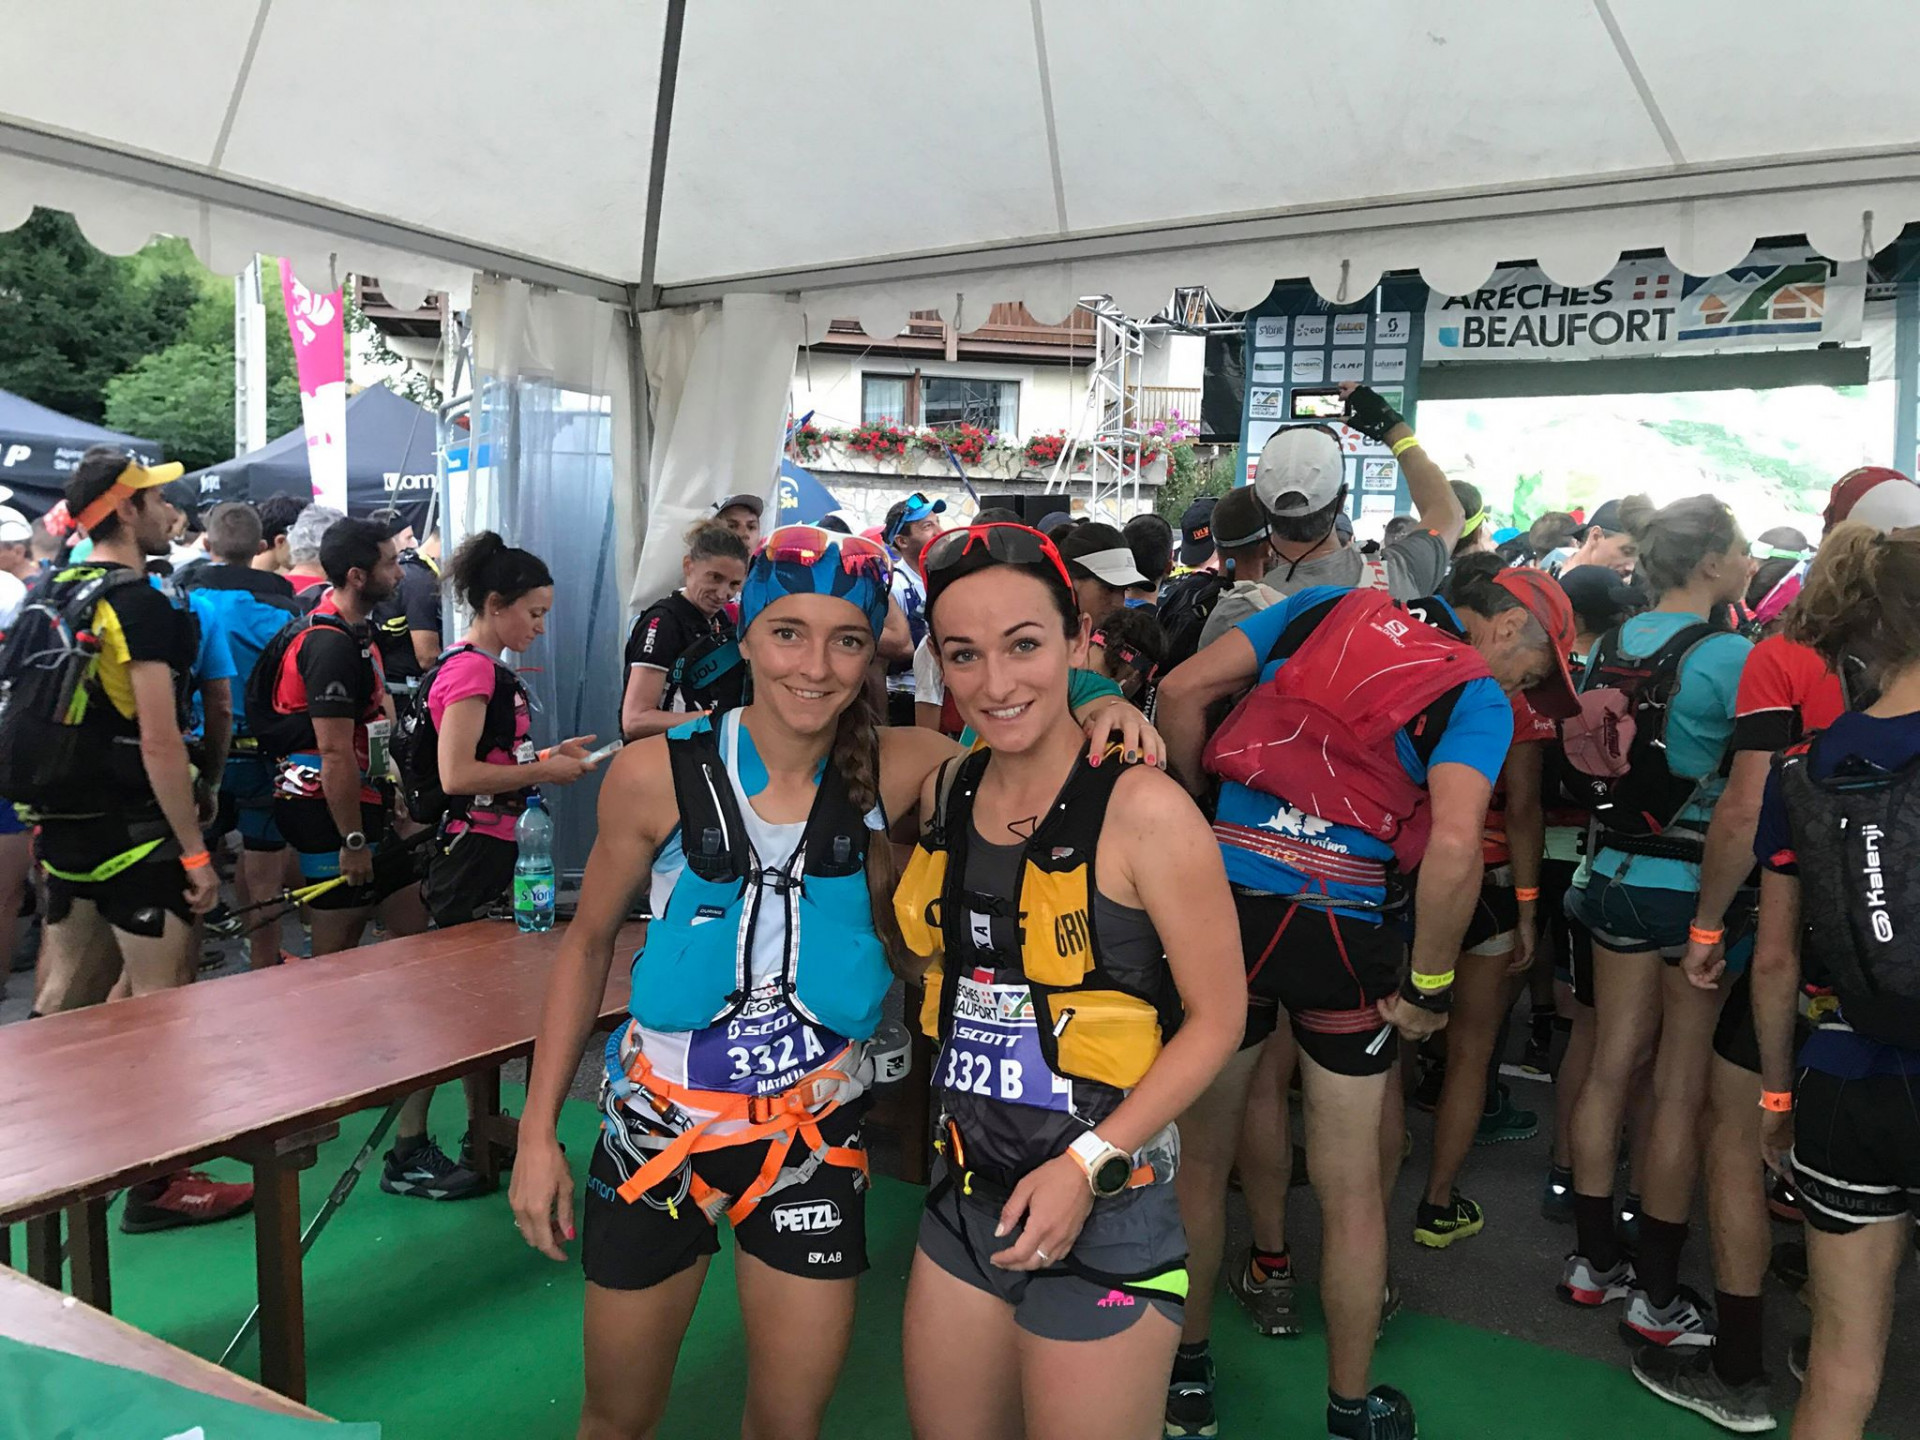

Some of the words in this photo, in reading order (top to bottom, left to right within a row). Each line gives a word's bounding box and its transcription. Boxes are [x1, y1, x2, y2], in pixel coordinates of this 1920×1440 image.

[1463, 308, 1676, 347] BEAUFORT
[1861, 824, 1888, 907] Kalenji
[726, 1034, 799, 1081] 332
[802, 1024, 826, 1062] A
[956, 1026, 1023, 1048] SCOTT
[944, 1048, 992, 1096] 332
[1000, 1058, 1024, 1100] B
[774, 1203, 843, 1233] PETZL
[1825, 1191, 1866, 1211] BLUE
